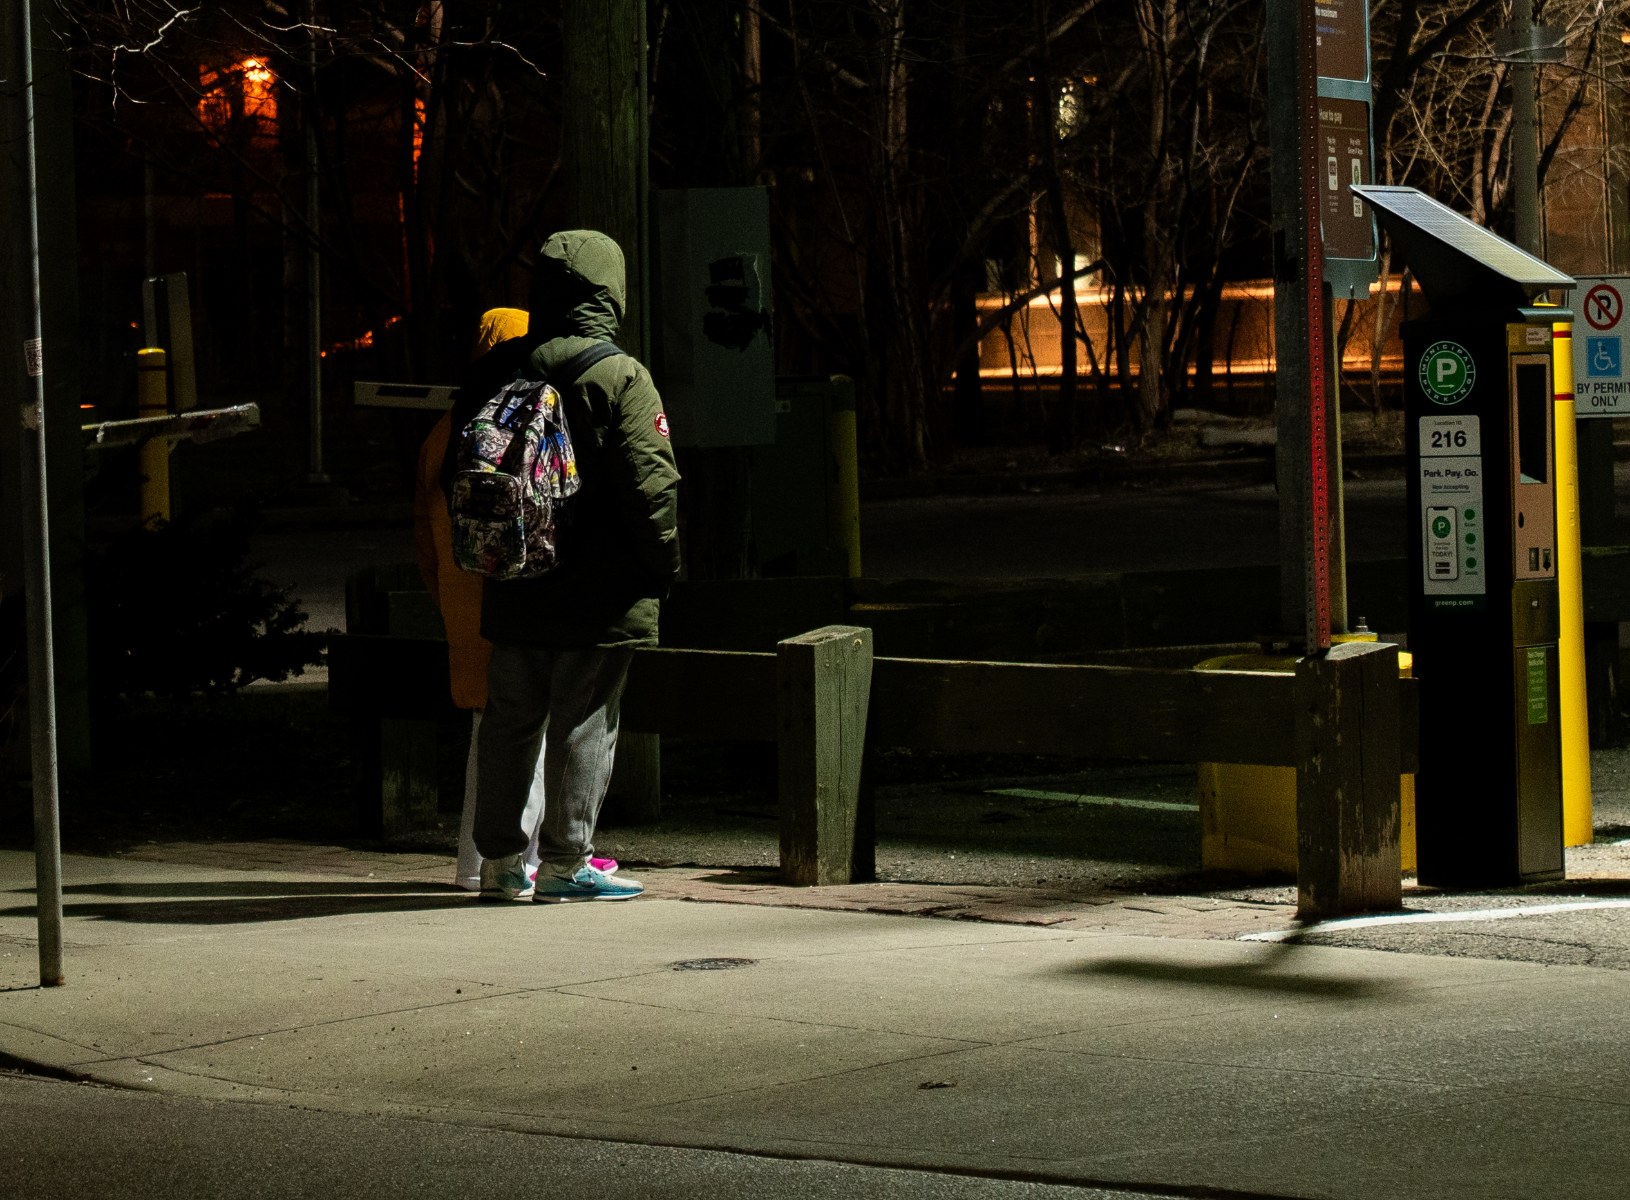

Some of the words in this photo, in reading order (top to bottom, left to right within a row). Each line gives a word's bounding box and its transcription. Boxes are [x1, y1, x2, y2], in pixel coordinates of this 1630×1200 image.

[1421, 344, 1472, 372] MUNICIPAL
[1436, 358, 1458, 382] P
[1422, 378, 1472, 402] PARKING
[1577, 383, 1590, 395] BY
[1591, 395, 1619, 407] ONLY
[1431, 431, 1466, 447] 216
[1445, 469, 1463, 479] Pay.
[1464, 468, 1479, 477] Go.
[1434, 600, 1474, 608] greenp.com
